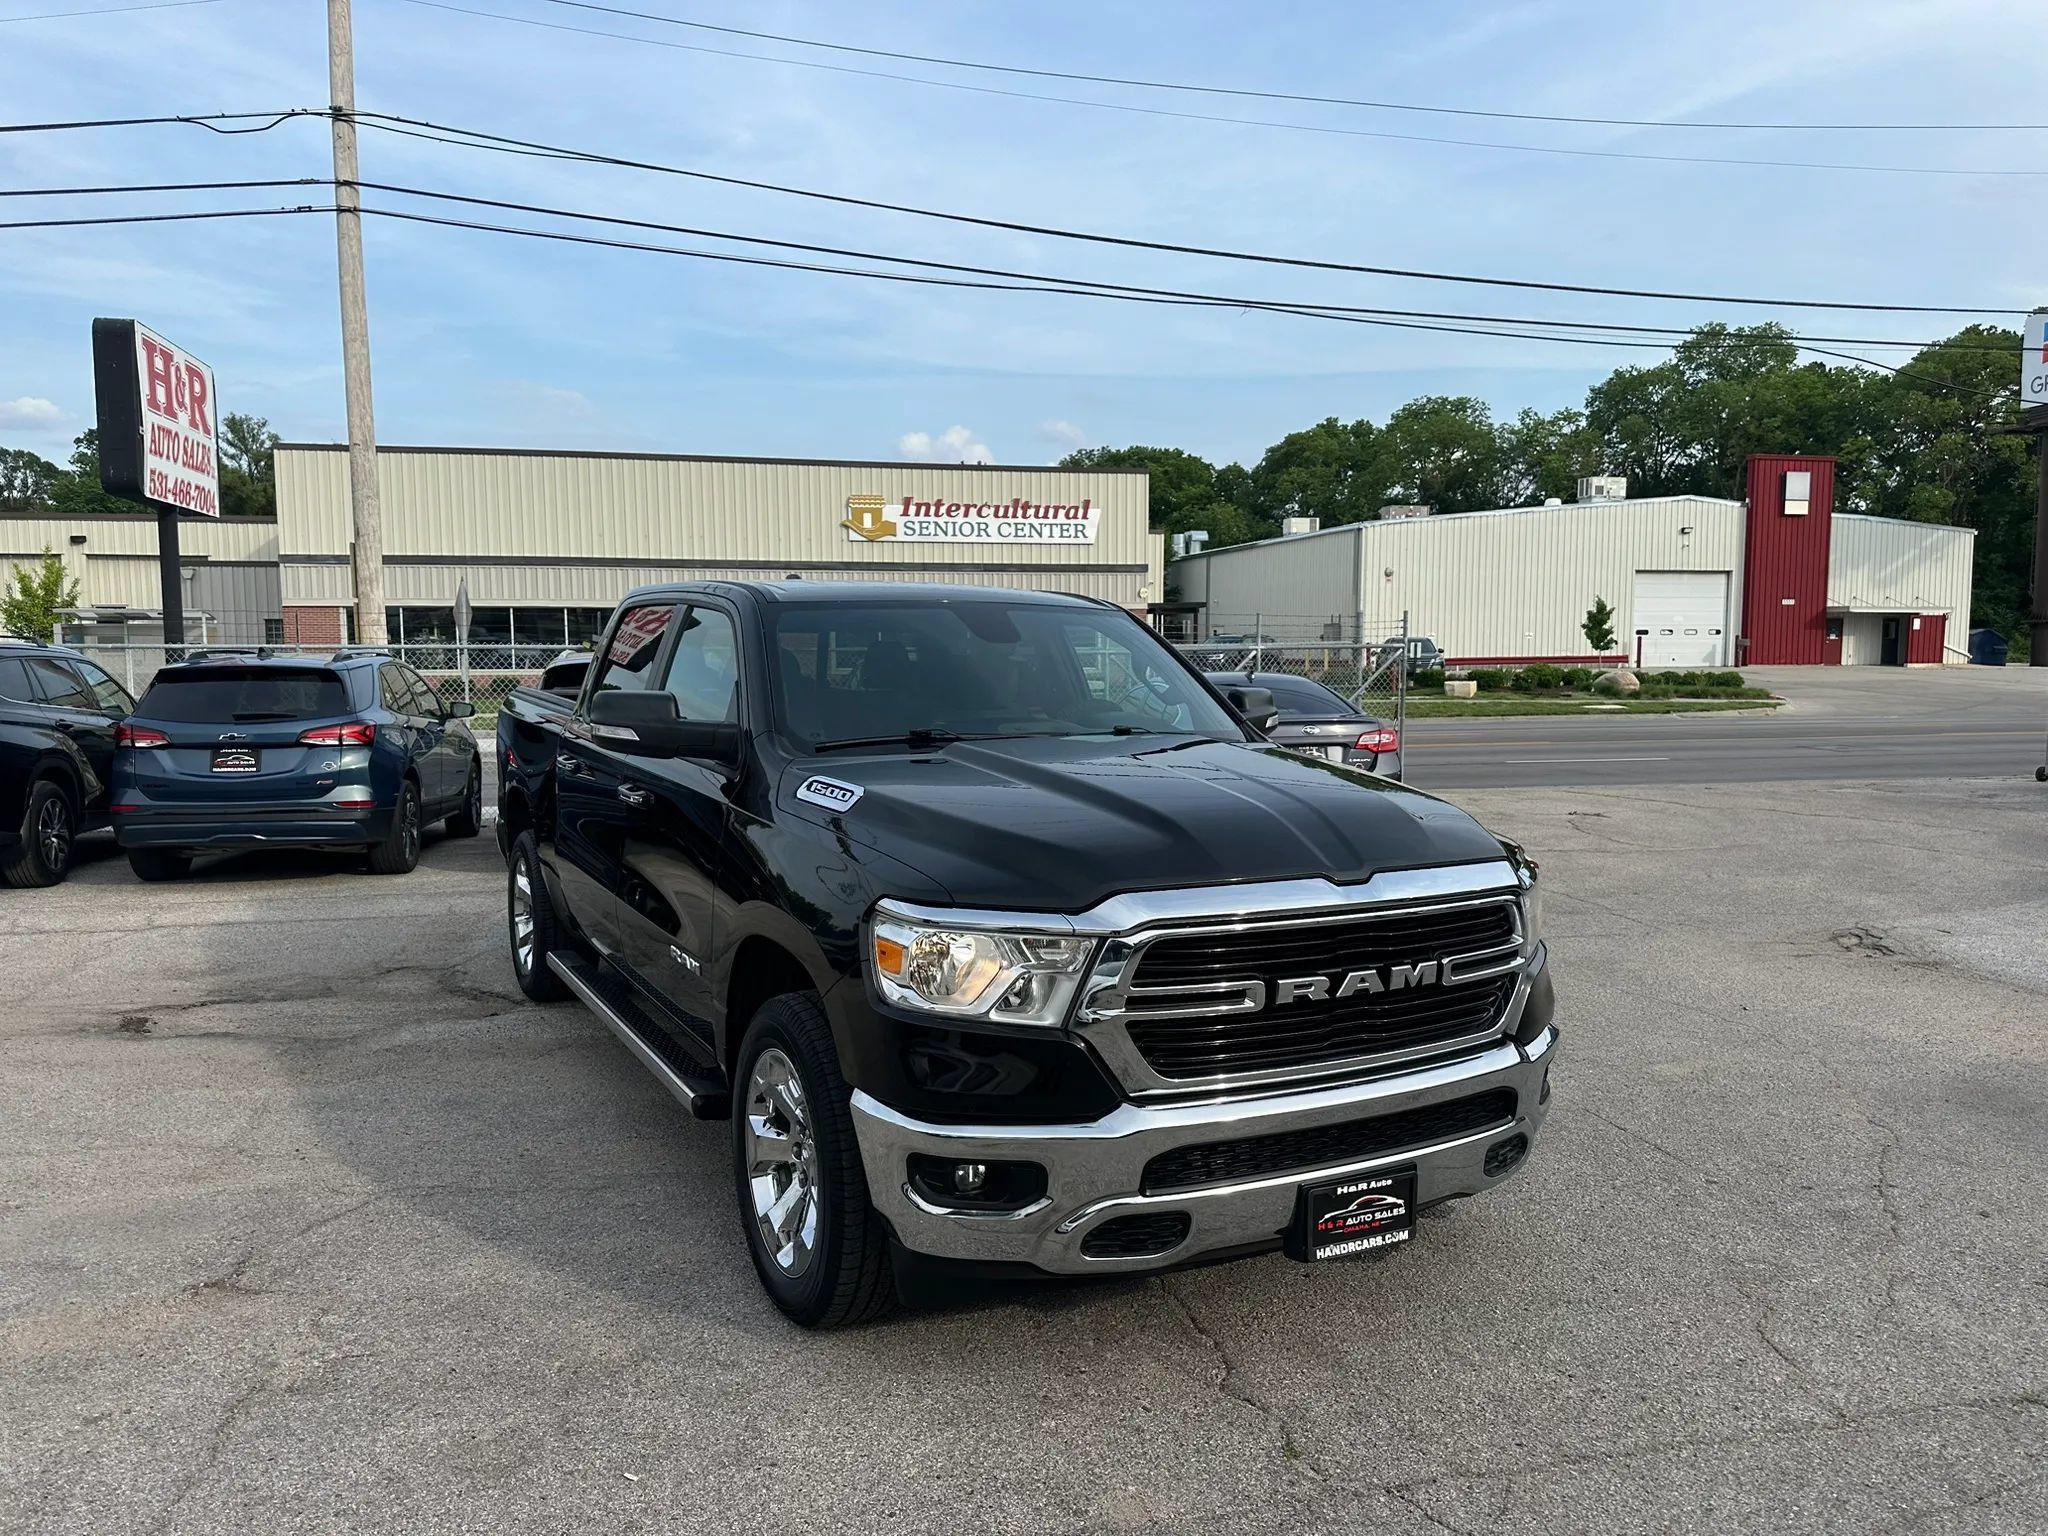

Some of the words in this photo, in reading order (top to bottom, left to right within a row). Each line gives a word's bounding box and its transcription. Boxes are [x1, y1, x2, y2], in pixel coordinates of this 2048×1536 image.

[141, 332, 212, 440] H&R
[149, 422, 180, 463] AUTO
[182, 435, 212, 477] SALES
[149, 468, 216, 514] 531-466-7004
[900, 496, 1091, 520] Intercultural
[904, 521, 991, 538] SENIOR
[998, 522, 1088, 539] CENTER
[810, 782, 853, 801] 1500
[1276, 961, 1438, 1004] RAM
[1369, 1179, 1392, 1189] Auto
[1336, 1219, 1344, 1227] R
[1345, 1214, 1373, 1225] AUTO
[1374, 1207, 1406, 1219] SALES
[1316, 1230, 1409, 1260] HANDRCARS.COM
